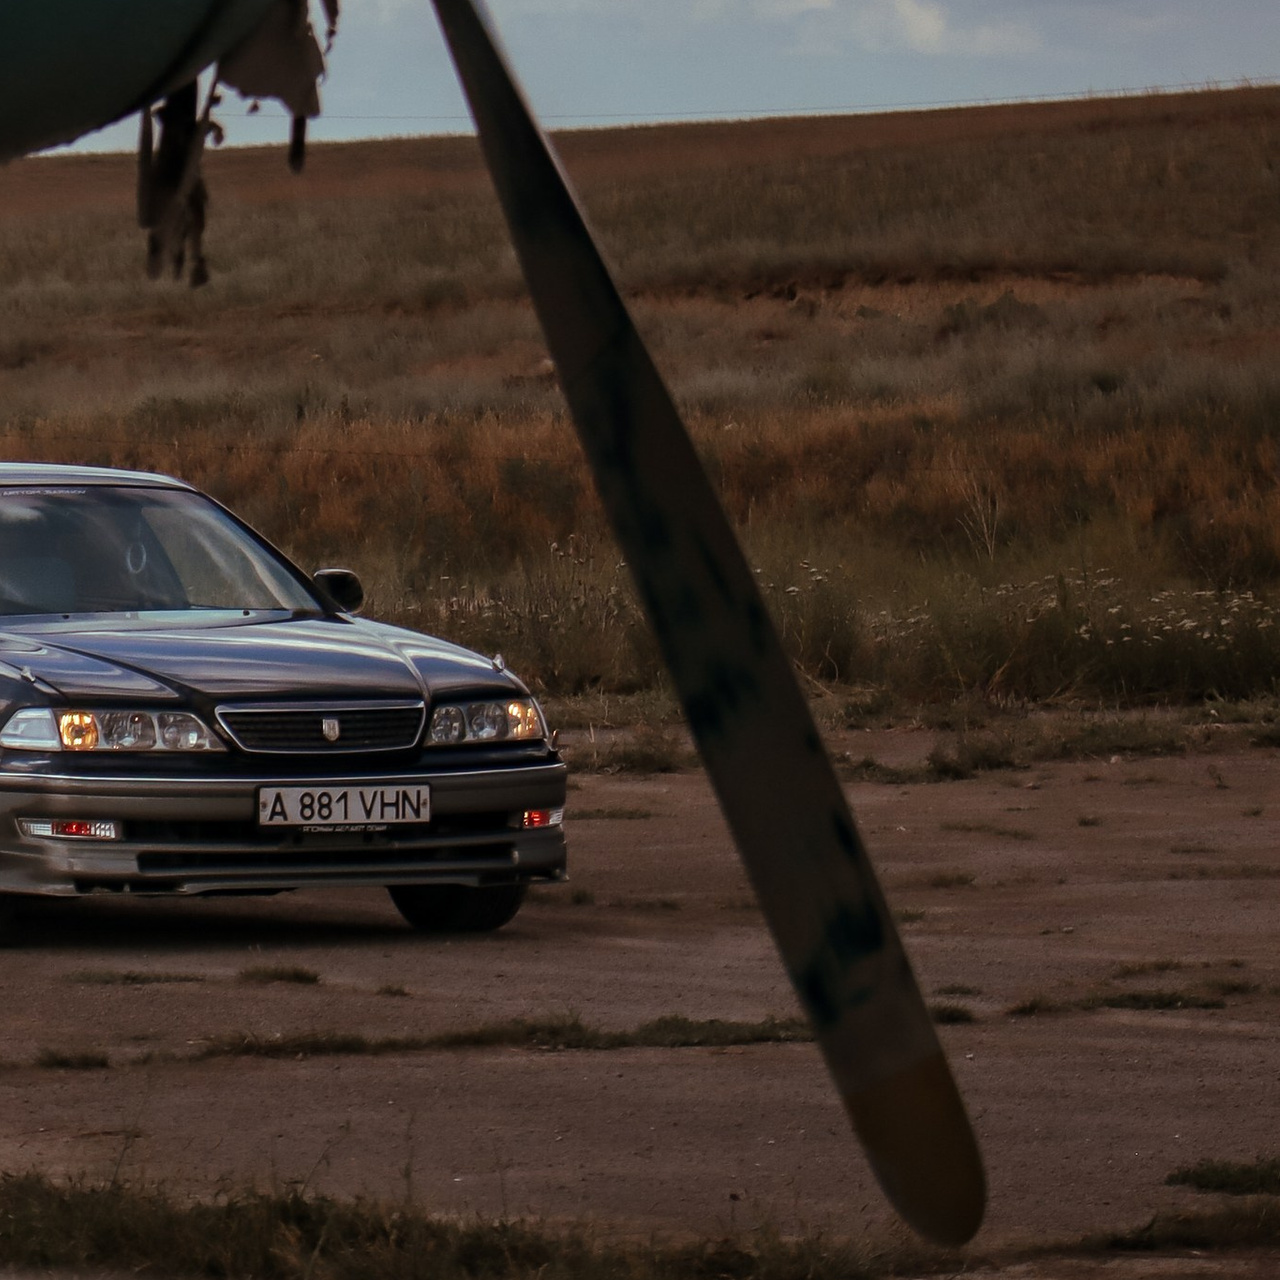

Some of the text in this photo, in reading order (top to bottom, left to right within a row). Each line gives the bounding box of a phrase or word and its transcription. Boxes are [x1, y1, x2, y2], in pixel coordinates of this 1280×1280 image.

[269, 789, 421, 821] A 881 VHN
